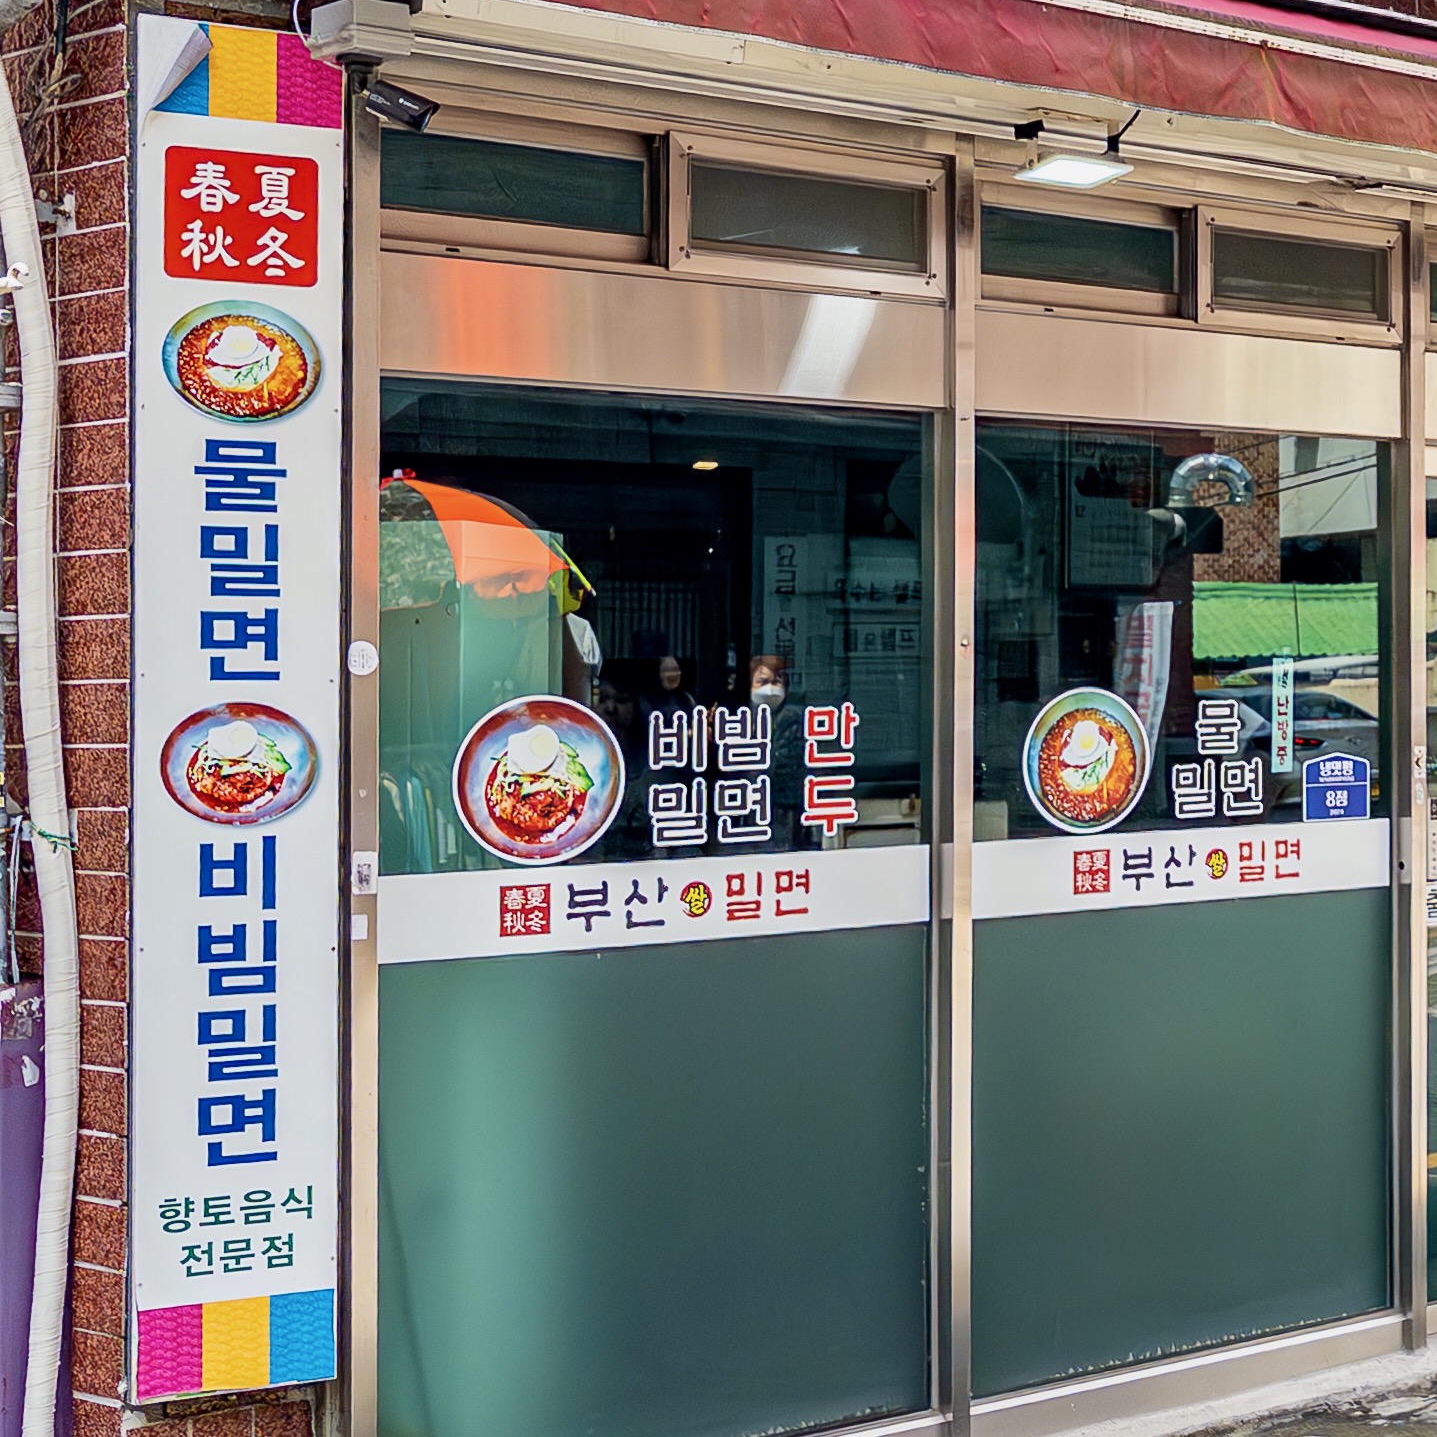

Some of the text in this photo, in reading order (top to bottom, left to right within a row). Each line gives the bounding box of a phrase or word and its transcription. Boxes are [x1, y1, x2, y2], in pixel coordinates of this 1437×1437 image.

[194, 439, 288, 681] 물밀면
[647, 704, 772, 772] 비빔
[1196, 698, 1242, 756] 물
[647, 775, 772, 847] 밀면
[1172, 756, 1263, 819] 밀면
[1325, 790, 1348, 807] 8점
[1122, 845, 1197, 890] 부산
[1238, 838, 1301, 882] 밀면
[566, 876, 669, 932] 부산
[725, 868, 810, 922] 밀면
[198, 834, 280, 1167] 비빔밀면
[158, 1184, 314, 1233] 향토음식
[179, 1232, 296, 1277] 전문점
